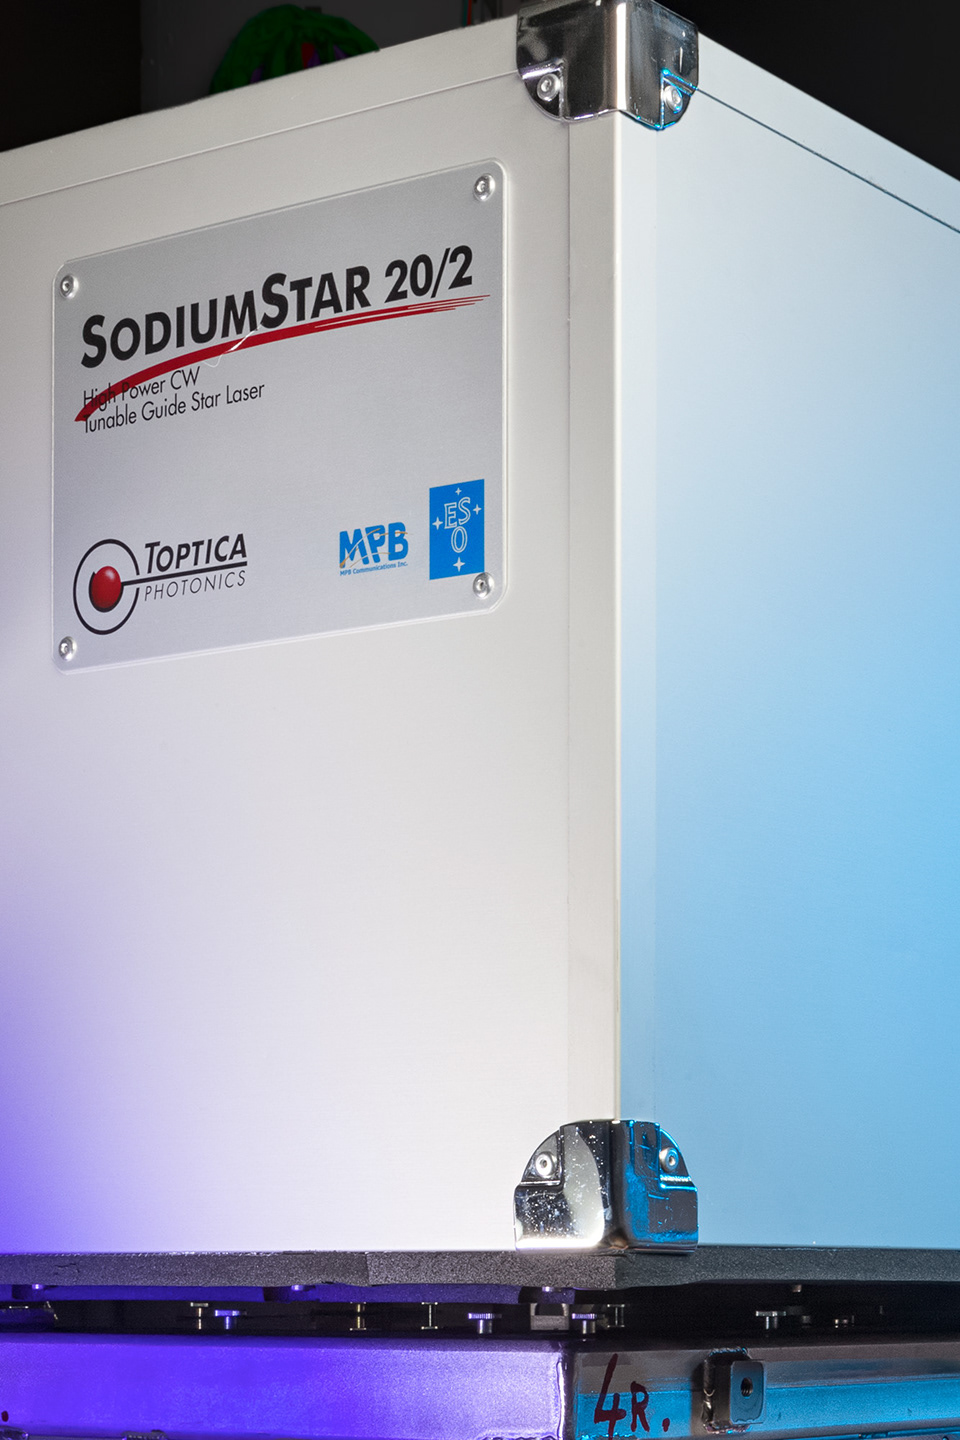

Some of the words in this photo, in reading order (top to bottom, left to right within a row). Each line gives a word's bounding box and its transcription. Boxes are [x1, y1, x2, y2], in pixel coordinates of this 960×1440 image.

[384, 245, 473, 303] 20/2
[83, 382, 116, 412] High
[122, 380, 166, 401] Power
[170, 366, 200, 391] CW
[83, 405, 137, 433] Tunable
[142, 394, 187, 421] Guide
[191, 391, 221, 412] Star
[226, 384, 265, 404] Laser
[143, 533, 248, 574] TOPTICA
[339, 522, 409, 568] MPB
[353, 562, 397, 575] Communications
[397, 560, 409, 568] Inc.
[144, 570, 246, 601] PHOTONICS
